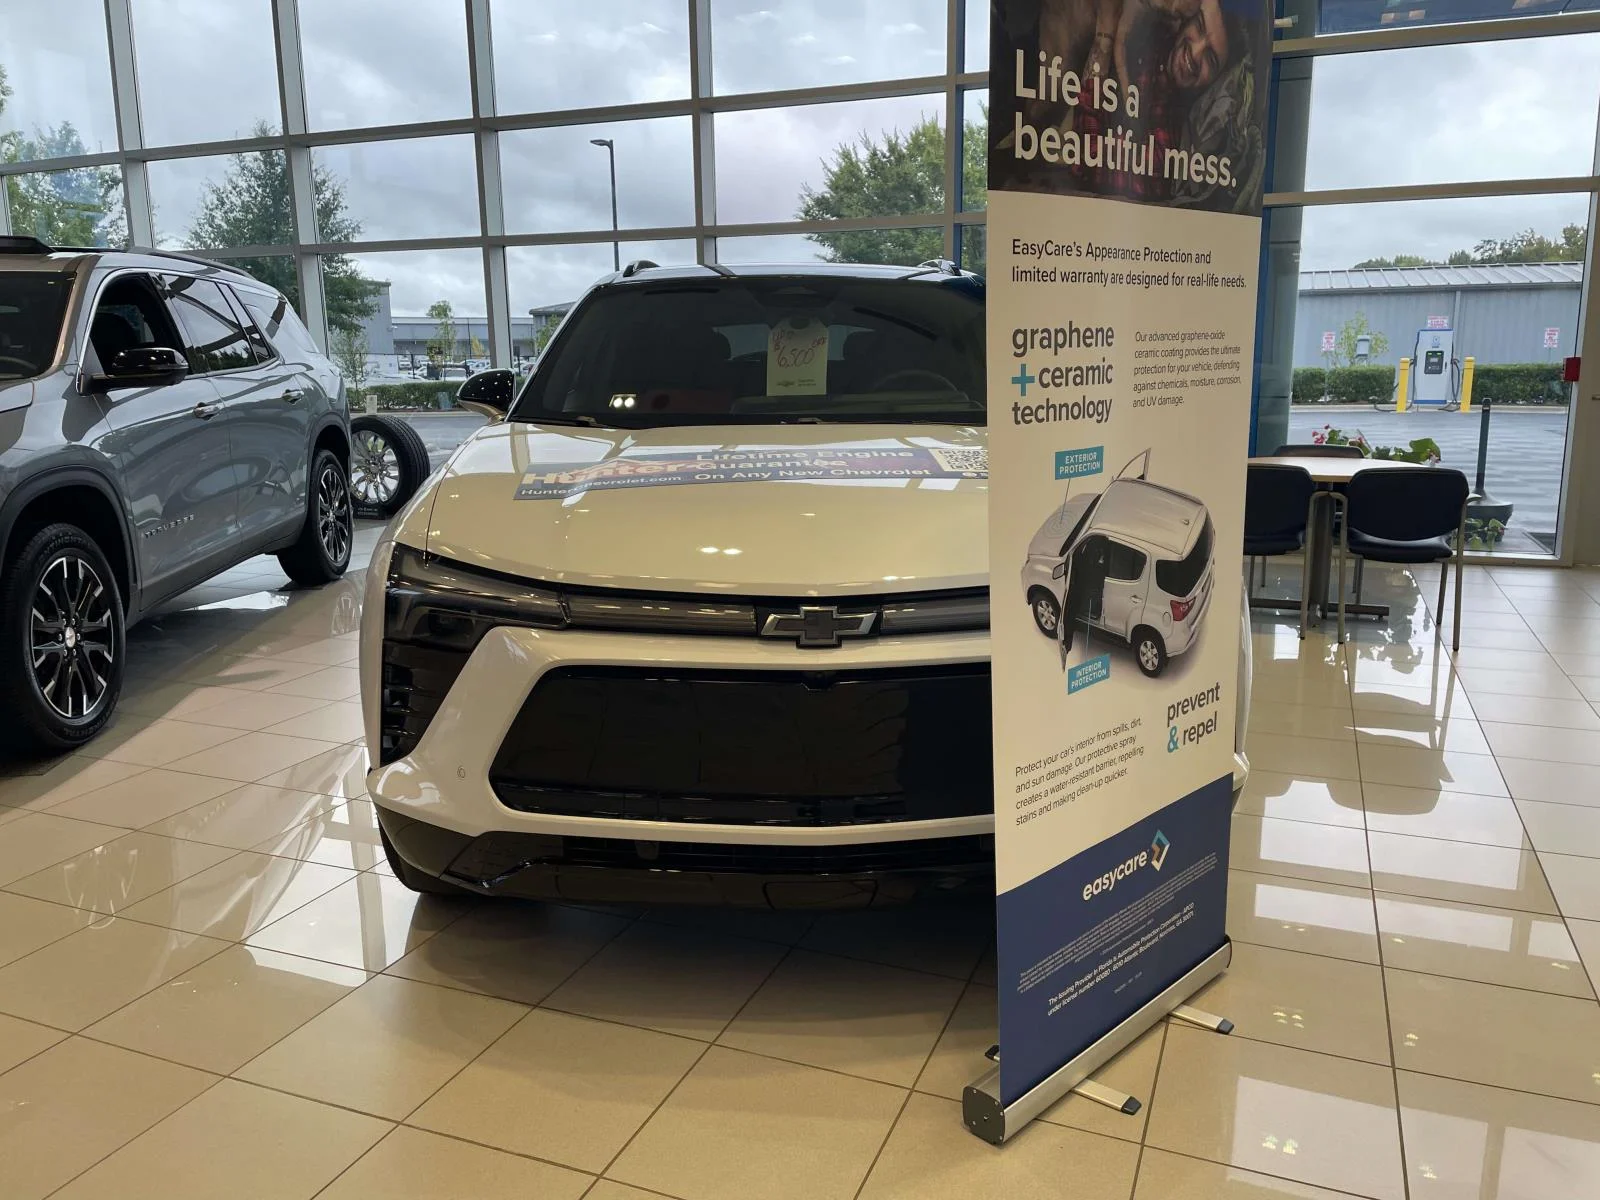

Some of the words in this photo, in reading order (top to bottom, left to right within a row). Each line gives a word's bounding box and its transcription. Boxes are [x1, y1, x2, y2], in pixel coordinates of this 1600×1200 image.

[1015, 49, 1082, 105] Life
[1093, 62, 1118, 112] is
[1127, 84, 1140, 118] a
[1014, 112, 1155, 176] beautiful
[1164, 146, 1237, 188] mess.
[1012, 239, 1082, 259] EasyCare's
[1085, 242, 1141, 262] Appearance
[1143, 247, 1193, 264] Protection
[1195, 251, 1212, 264] and
[1012, 266, 1057, 283] limited
[1060, 270, 1109, 287] warranty
[1111, 273, 1124, 285] are
[1125, 270, 1169, 289] designed
[1172, 272, 1185, 287] for
[1187, 273, 1219, 288] real-life
[1221, 274, 1247, 288] needs.
[1012, 320, 1115, 358] graphene
[1135, 331, 1147, 342] Our
[1148, 331, 1179, 342] advanced
[1180, 330, 1226, 344] graphene-oxide
[1134, 349, 1159, 358] ceramic
[1161, 348, 1184, 360] coating
[1185, 346, 1210, 358] provides
[1211, 346, 1220, 356] the
[1220, 345, 1241, 355] ultimate
[1038, 357, 1114, 389] ceramic
[1134, 364, 1165, 376] protection
[1167, 363, 1176, 374] for
[1177, 364, 1190, 375] your
[1192, 361, 1213, 372] vehicle,
[1213, 360, 1240, 371] defending
[1133, 381, 1157, 393] against
[1157, 379, 1188, 390] chemicals,
[1190, 377, 1215, 387] moisture,
[1012, 395, 1113, 426] technology
[1133, 396, 1145, 408] and
[1146, 396, 1157, 407] UV
[1157, 395, 1184, 407] damage.
[696, 449, 808, 461] Lifetime
[817, 449, 914, 460] Engine
[697, 459, 849, 470] Guarantee
[1065, 451, 1097, 464] EXTERIOR
[521, 462, 684, 485] Hunter
[694, 473, 724, 481] On
[731, 471, 771, 479] Any
[779, 469, 823, 477] New
[831, 468, 932, 476] Chevrolet
[1059, 461, 1101, 475] PROTECTION
[1071, 668, 1107, 689] PROTECTION
[1076, 661, 1102, 678] INTERIOR
[1167, 682, 1220, 727] prevent
[1167, 726, 1179, 753] &
[1183, 711, 1217, 745] repel
[1015, 760, 1042, 777] Protect
[1043, 752, 1058, 768] your
[1060, 745, 1074, 759] car's
[1075, 736, 1096, 751] interior
[1096, 730, 1112, 742] from
[1112, 722, 1129, 736] spills,
[1015, 780, 1031, 794] and
[1031, 774, 1044, 787] sun
[1046, 762, 1073, 781] damage.
[1074, 754, 1087, 767] Our
[1087, 741, 1118, 763] protective
[1119, 735, 1136, 749] spray
[1015, 792, 1043, 810] creates
[1044, 788, 1049, 798] a
[1049, 765, 1095, 795] water-resistant
[1095, 757, 1117, 773] barrier,
[1118, 746, 1144, 763] repelling
[1016, 810, 1037, 826] stains
[1038, 802, 1052, 816] and
[1052, 790, 1076, 808] making
[1076, 778, 1103, 797] clean-up
[1104, 767, 1128, 785] quicker.
[1083, 851, 1147, 900] easycare
